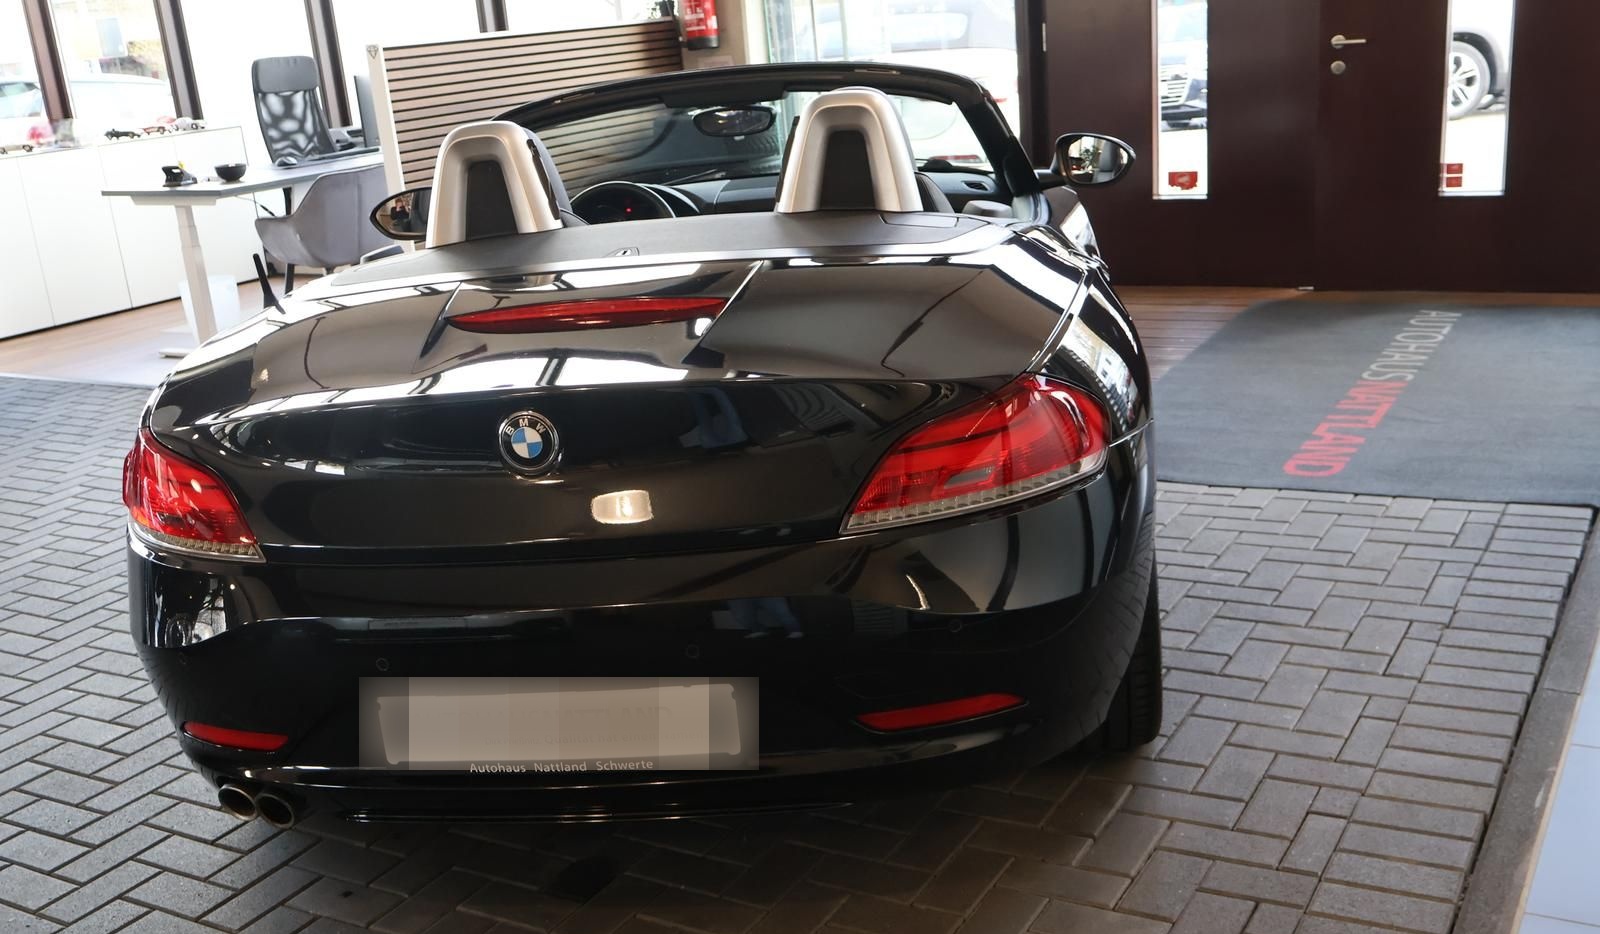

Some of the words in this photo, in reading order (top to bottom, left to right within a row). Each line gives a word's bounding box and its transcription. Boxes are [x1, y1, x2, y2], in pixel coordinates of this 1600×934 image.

[505, 418, 547, 436] BMW
[470, 762, 526, 774] Autohaus
[533, 761, 588, 773] Nattland
[595, 759, 654, 772] Schwerte
